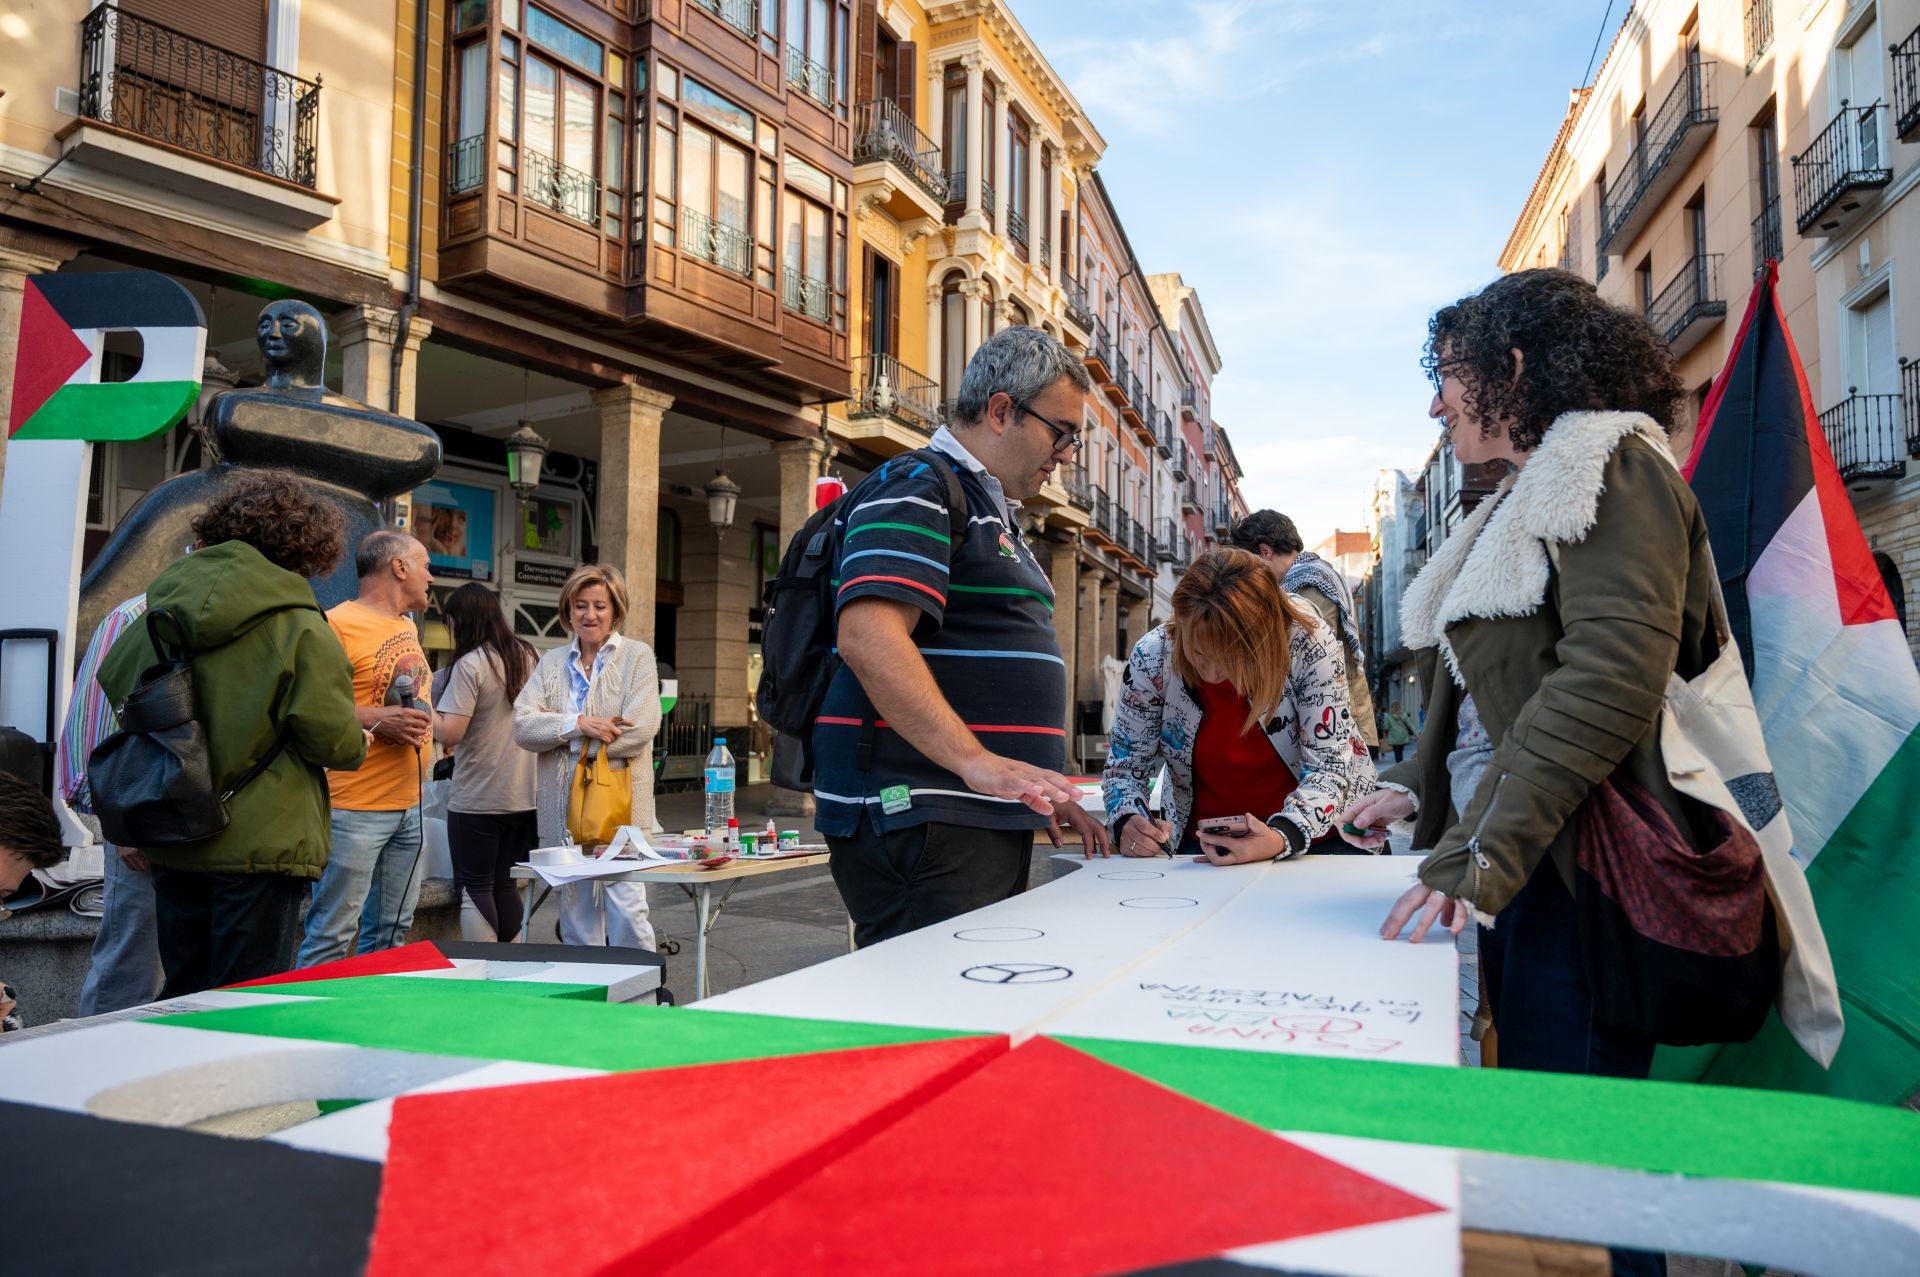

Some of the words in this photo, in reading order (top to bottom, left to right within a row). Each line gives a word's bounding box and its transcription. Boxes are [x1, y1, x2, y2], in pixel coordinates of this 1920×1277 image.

[1138, 983, 1335, 1004] PALESTINA
[1303, 1001, 1371, 1014] que
[1188, 1024, 1297, 1043] UNA
